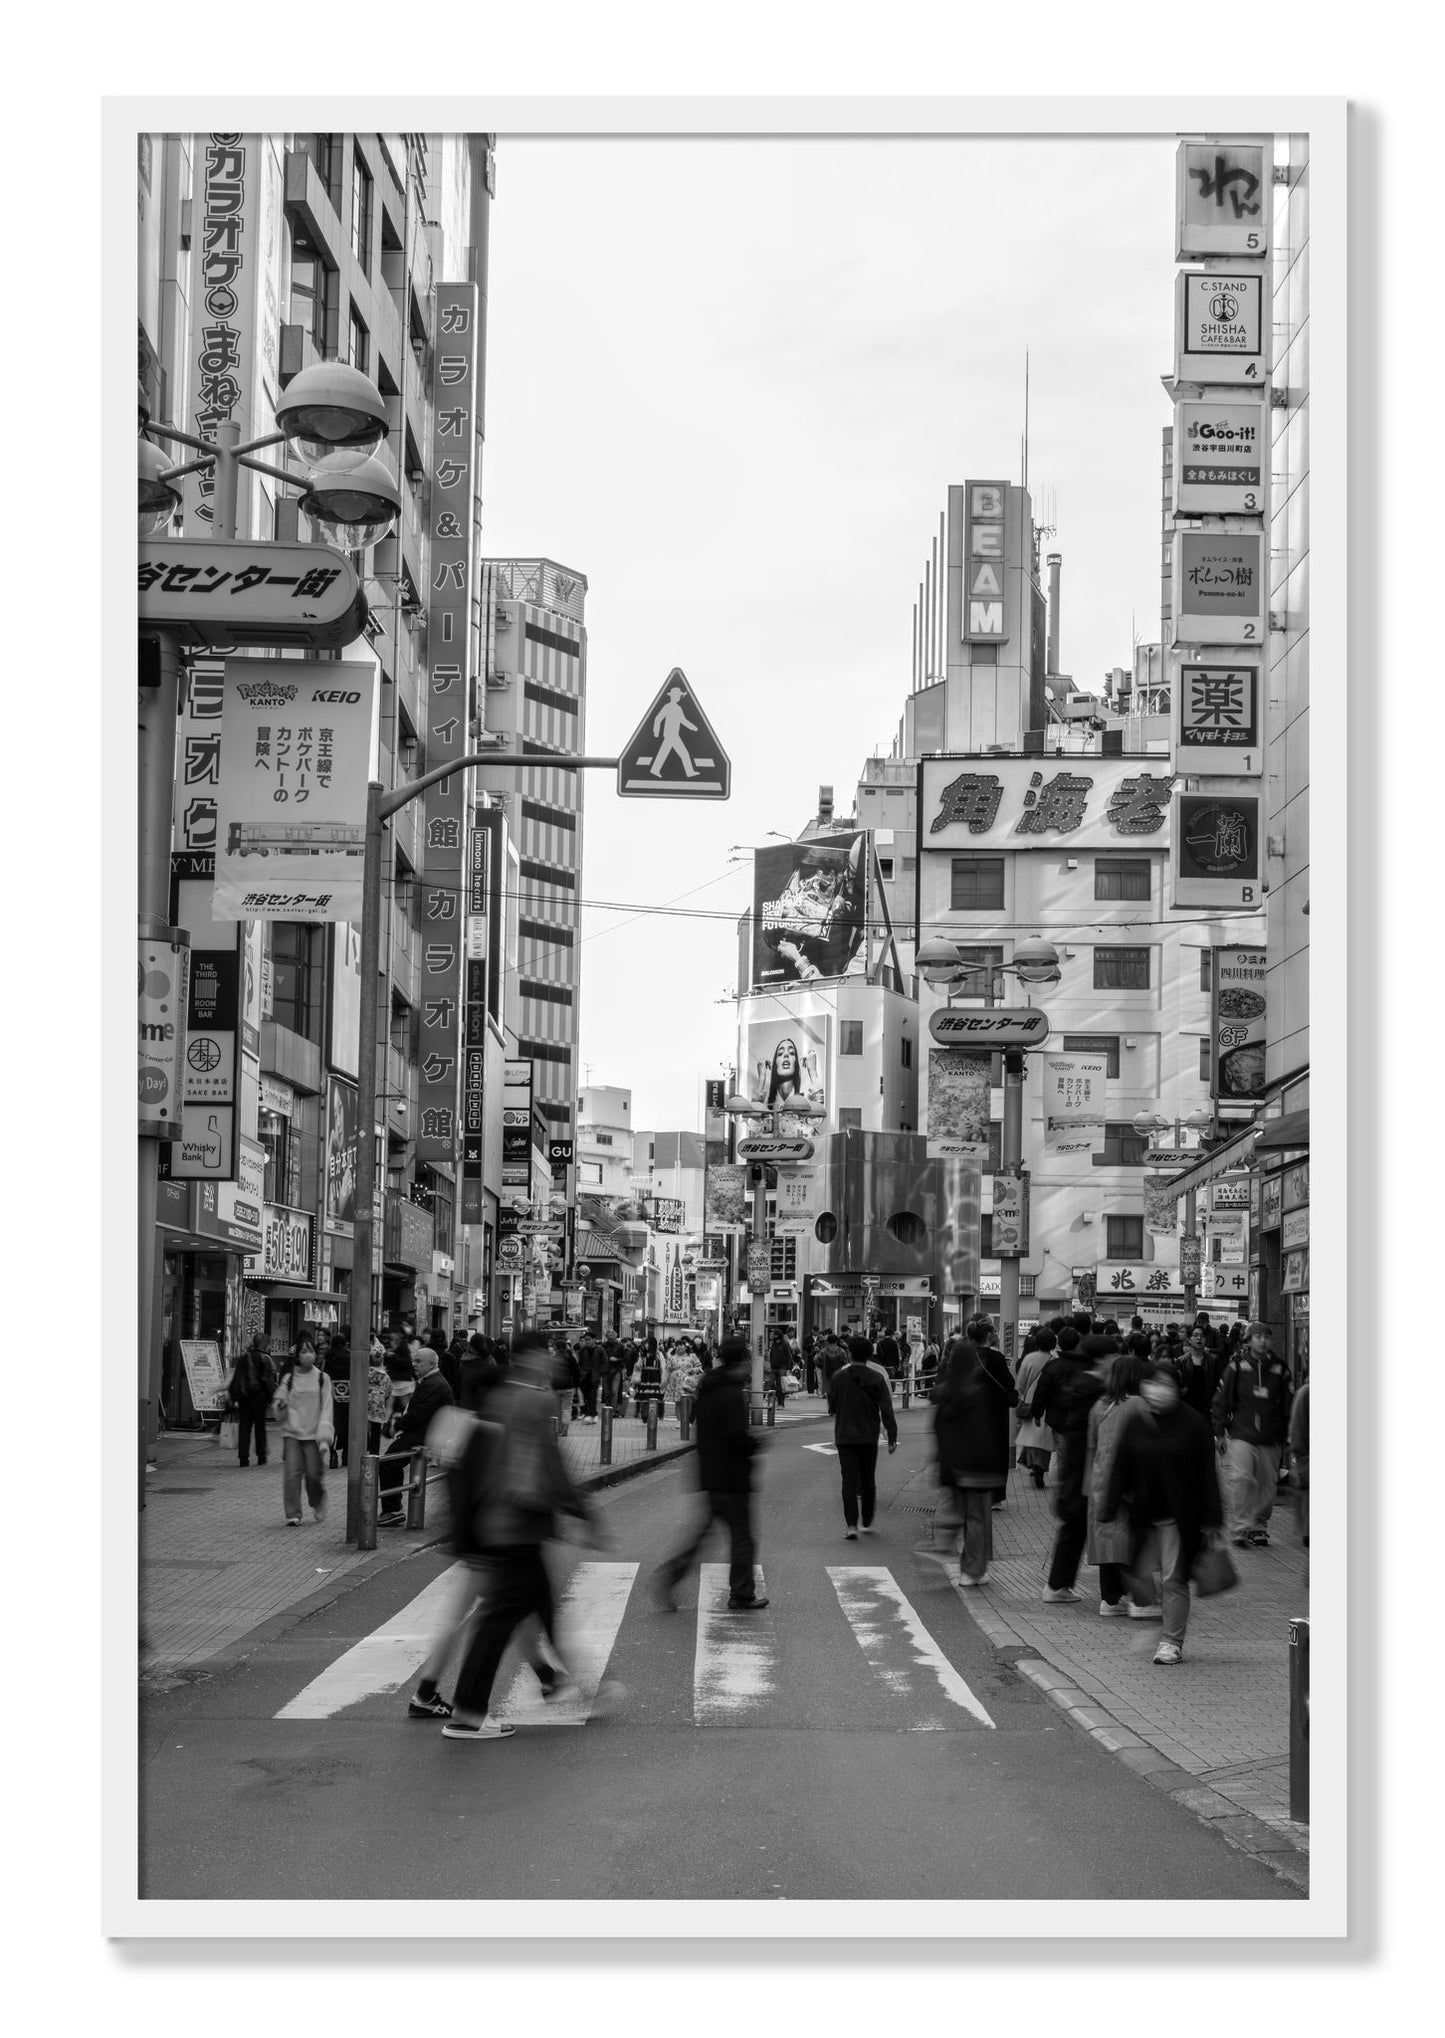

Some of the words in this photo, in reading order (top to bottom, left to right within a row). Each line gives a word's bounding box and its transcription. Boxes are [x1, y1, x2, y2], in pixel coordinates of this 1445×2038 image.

[1246, 233, 1259, 249] 5
[1201, 282, 1247, 292] C.STAND
[1201, 323, 1247, 335] SHISHA
[1201, 335, 1247, 344] CAFE&BAR
[1245, 363, 1258, 379] 4
[1199, 424, 1255, 440] Goo-it!
[1187, 470, 1256, 481] 全身もみほぐし
[1244, 493, 1257, 510] 3
[970, 485, 1003, 634] BEAM
[1243, 623, 1256, 640] 2
[250, 698, 286, 706] KANTO
[311, 690, 362, 704] KEIO
[1192, 673, 1243, 725] 薬
[1185, 728, 1249, 743] マツモトキヨシ
[254, 726, 271, 770] 冒険へ
[273, 726, 292, 802] カントーの
[316, 728, 334, 789] 京王線で
[1243, 754, 1252, 771] 1
[930, 772, 1174, 834] 角海老
[1186, 812, 1247, 861] 一蘭
[474, 833, 483, 870] kimono
[241, 893, 333, 907] 渋谷センター街
[1242, 886, 1253, 902] B
[936, 1017, 1042, 1031] 渋谷センター街
[1218, 1026, 1248, 1047] 6F
[182, 1143, 216, 1154] Whisky
[551, 1146, 572, 1157] GU
[182, 1153, 203, 1161] Bank
[672, 1267, 682, 1310] BEER
